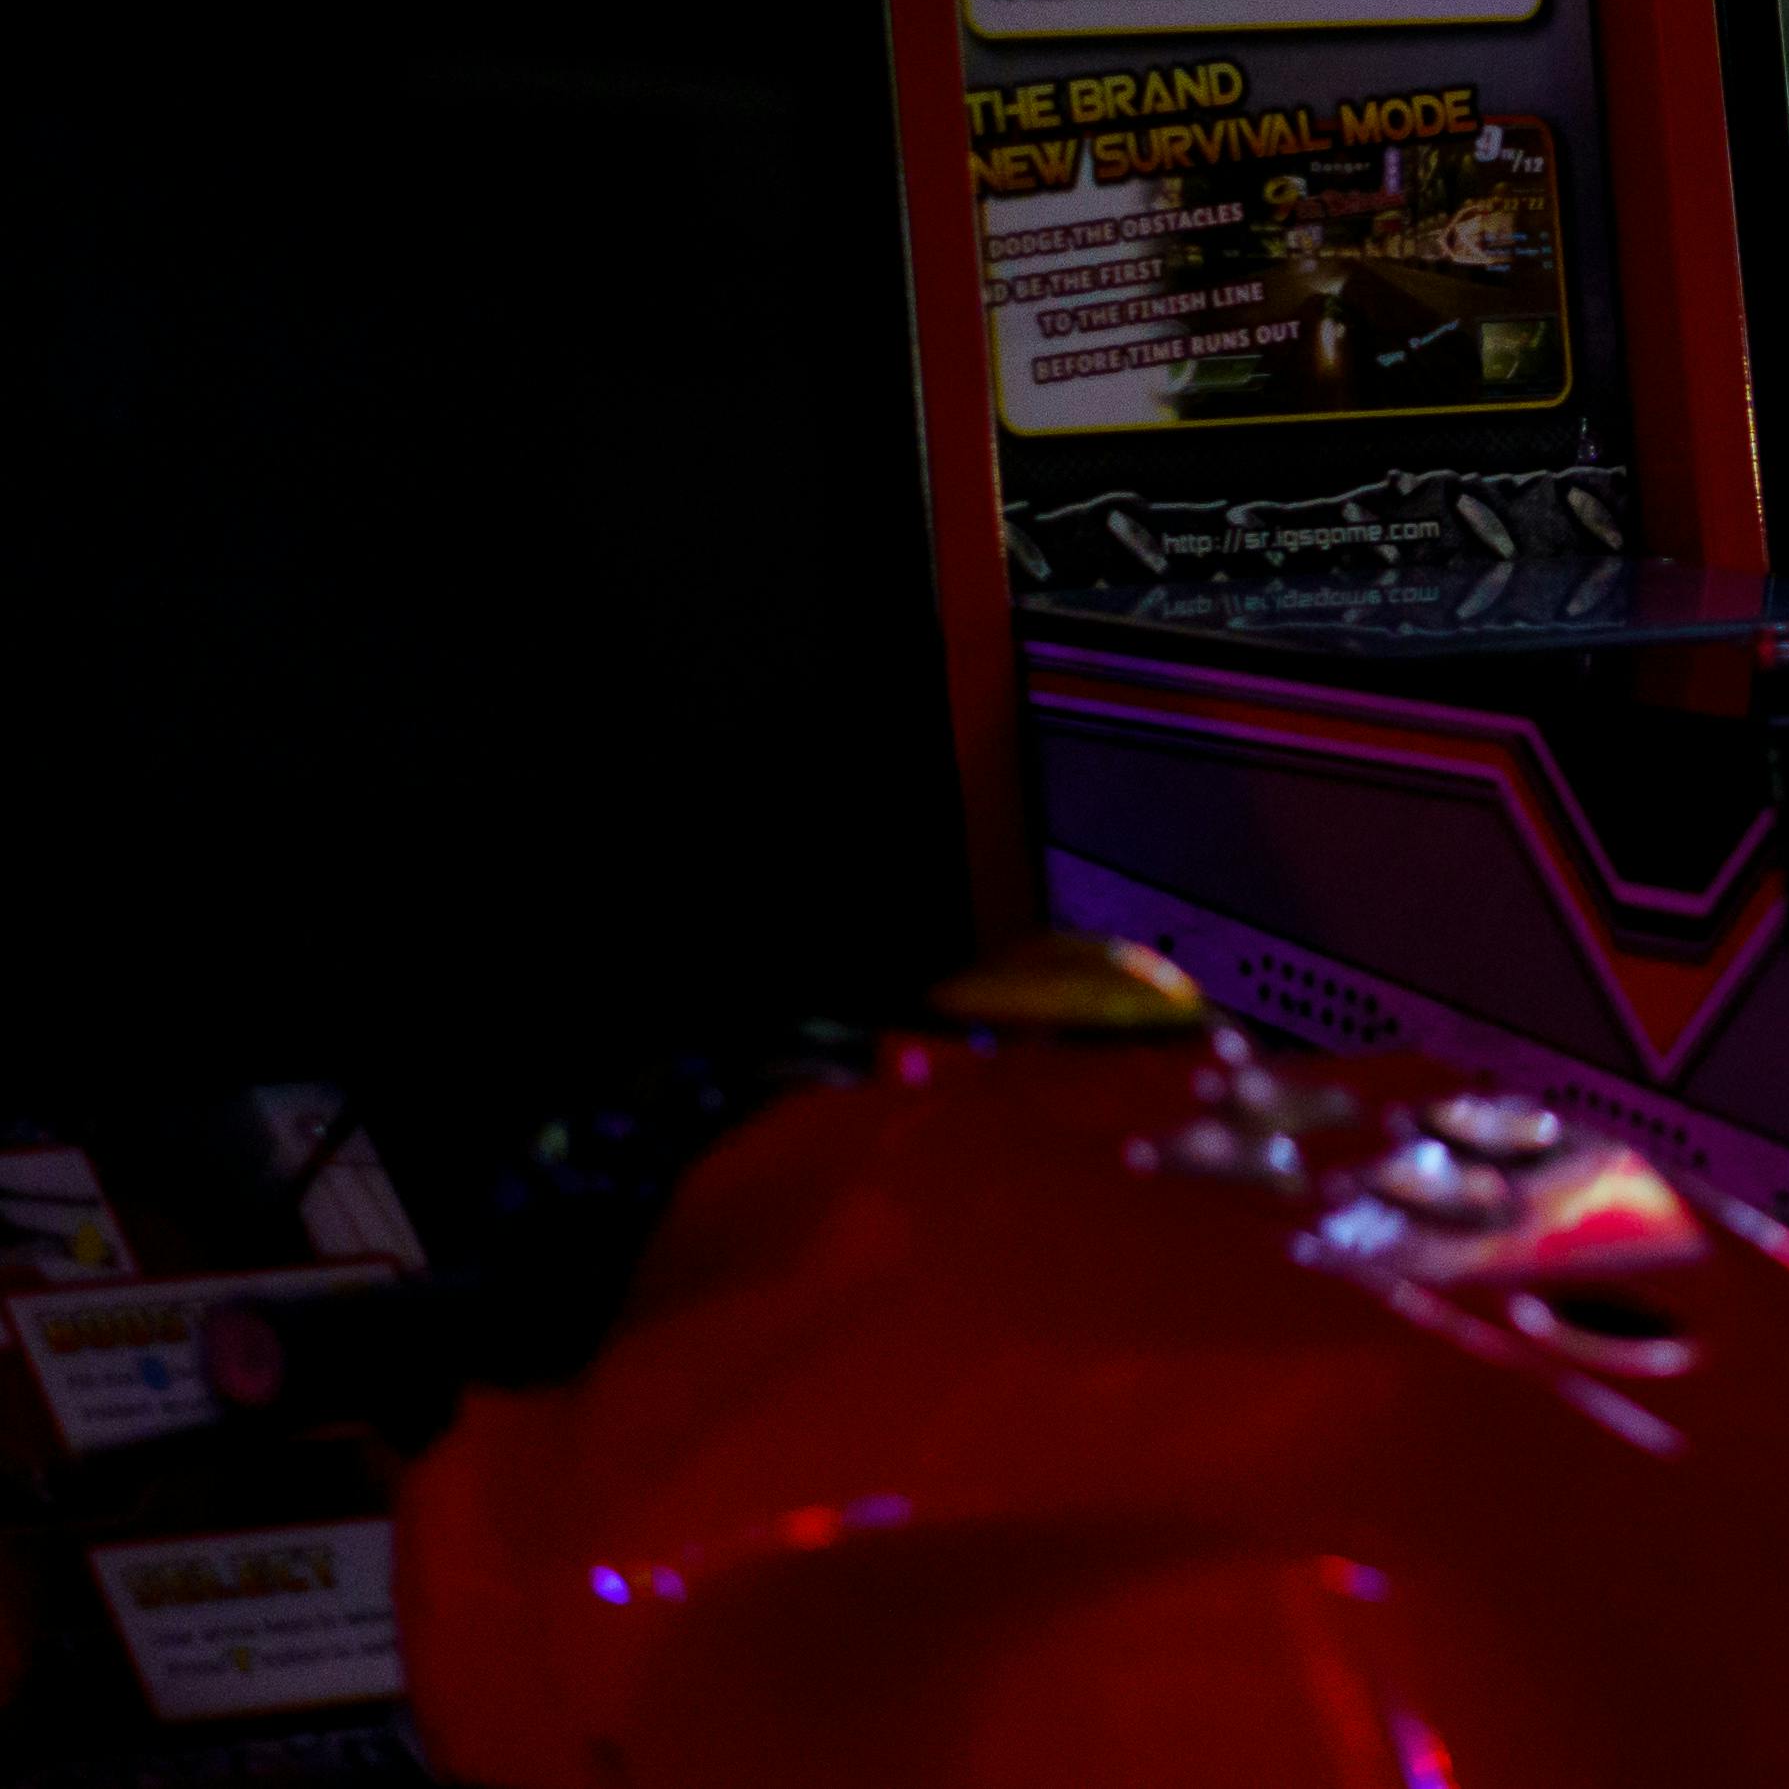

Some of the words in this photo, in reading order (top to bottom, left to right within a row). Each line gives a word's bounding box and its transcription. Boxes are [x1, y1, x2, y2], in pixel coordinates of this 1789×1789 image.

[965, 82, 1063, 137] THE
[1068, 61, 1245, 125] BRAND
[971, 138, 1078, 192] NEW
[1092, 109, 1334, 183] SURVIVAL
[1339, 87, 1479, 147] MODE
[1070, 222, 1116, 249] THE
[1120, 202, 1245, 239] OBSTACLES
[1012, 276, 1044, 300] BE
[1048, 270, 1093, 295] THE
[1099, 258, 1165, 287] FIRST
[1038, 311, 1073, 337] TO
[1076, 304, 1122, 331] THE
[1126, 291, 1208, 322] FINISH
[1209, 282, 1266, 309] LINE
[1033, 349, 1122, 384] BEFORE
[1125, 337, 1187, 365] TIME
[1189, 328, 1252, 356] RUNS
[1253, 320, 1303, 346] OUT
